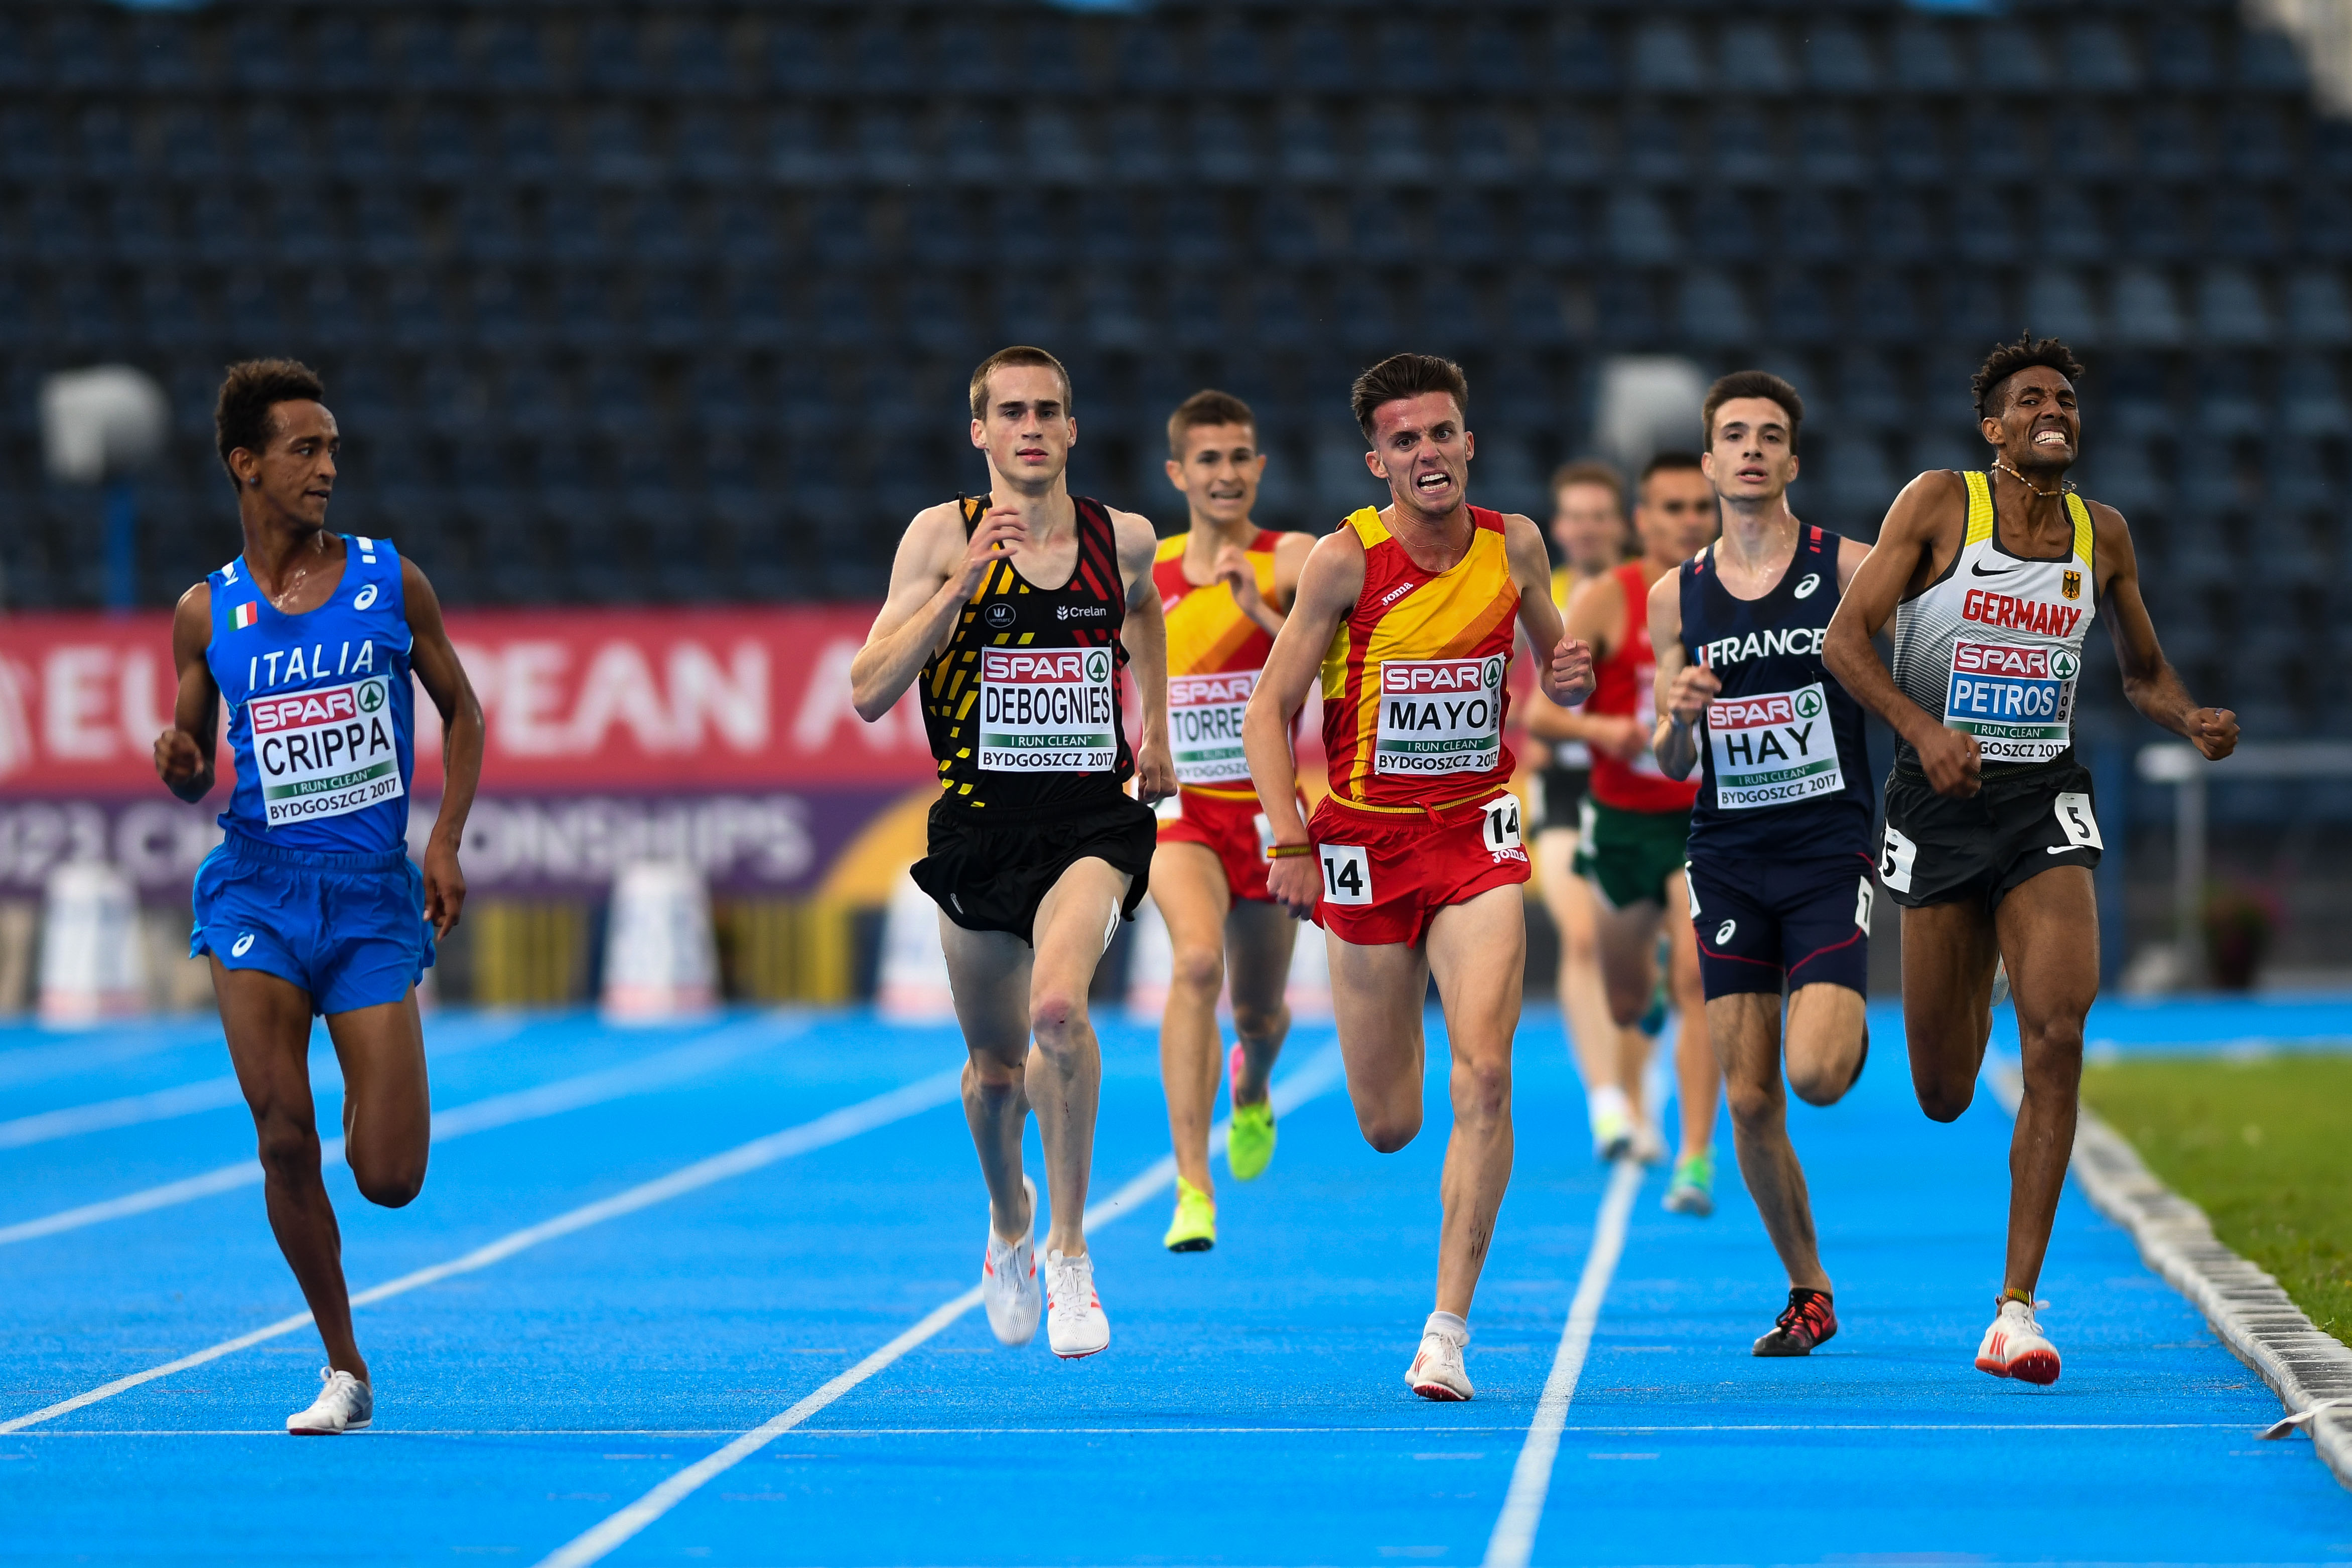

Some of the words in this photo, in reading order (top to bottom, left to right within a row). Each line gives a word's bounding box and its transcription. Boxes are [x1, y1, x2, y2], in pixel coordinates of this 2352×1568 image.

[1070, 606, 1106, 617] Crelan
[1962, 588, 2082, 638] GERMANY
[1707, 628, 1827, 669] FRANCE
[1957, 646, 2046, 674] SPAR
[249, 640, 373, 690] ITALIA
[987, 656, 1080, 679] SPAR
[1386, 666, 1479, 690] SPAR
[986, 686, 1110, 725] DEBOGNIES
[1171, 679, 1251, 703] SPAR
[1953, 679, 2055, 716] PETROS
[255, 693, 353, 730] SPAR
[1172, 707, 1245, 742] TORRE
[1389, 699, 1488, 731] MAYO
[1710, 699, 1792, 727] SPAR
[262, 717, 390, 775] CRIPPA
[1012, 737, 1014, 746] I
[1019, 737, 1044, 746] RUN
[1725, 722, 1814, 766] HAY
[1975, 724, 1978, 734] I
[1981, 725, 2006, 736] RUN
[983, 753, 1083, 767] BYDGOSZCZ
[1087, 752, 1114, 766] 2017
[1378, 754, 1471, 770] BYDGOSZCZ
[1475, 750, 1498, 767] 2017
[1408, 743, 1411, 751] I
[1415, 742, 1439, 752] RUN
[293, 784, 297, 795] I
[301, 778, 327, 794] RUN
[1722, 782, 1806, 804] BYDGOSZCZ
[1809, 774, 1837, 792] 2017
[1739, 776, 1742, 785] I
[1745, 773, 1768, 785] RUN
[270, 790, 368, 819] BYDGOSZCZ
[370, 777, 396, 798] 2017
[1490, 802, 1520, 844] 14
[2066, 806, 2091, 839] 5
[1882, 839, 1899, 877] 5
[1324, 858, 1363, 896] 14
